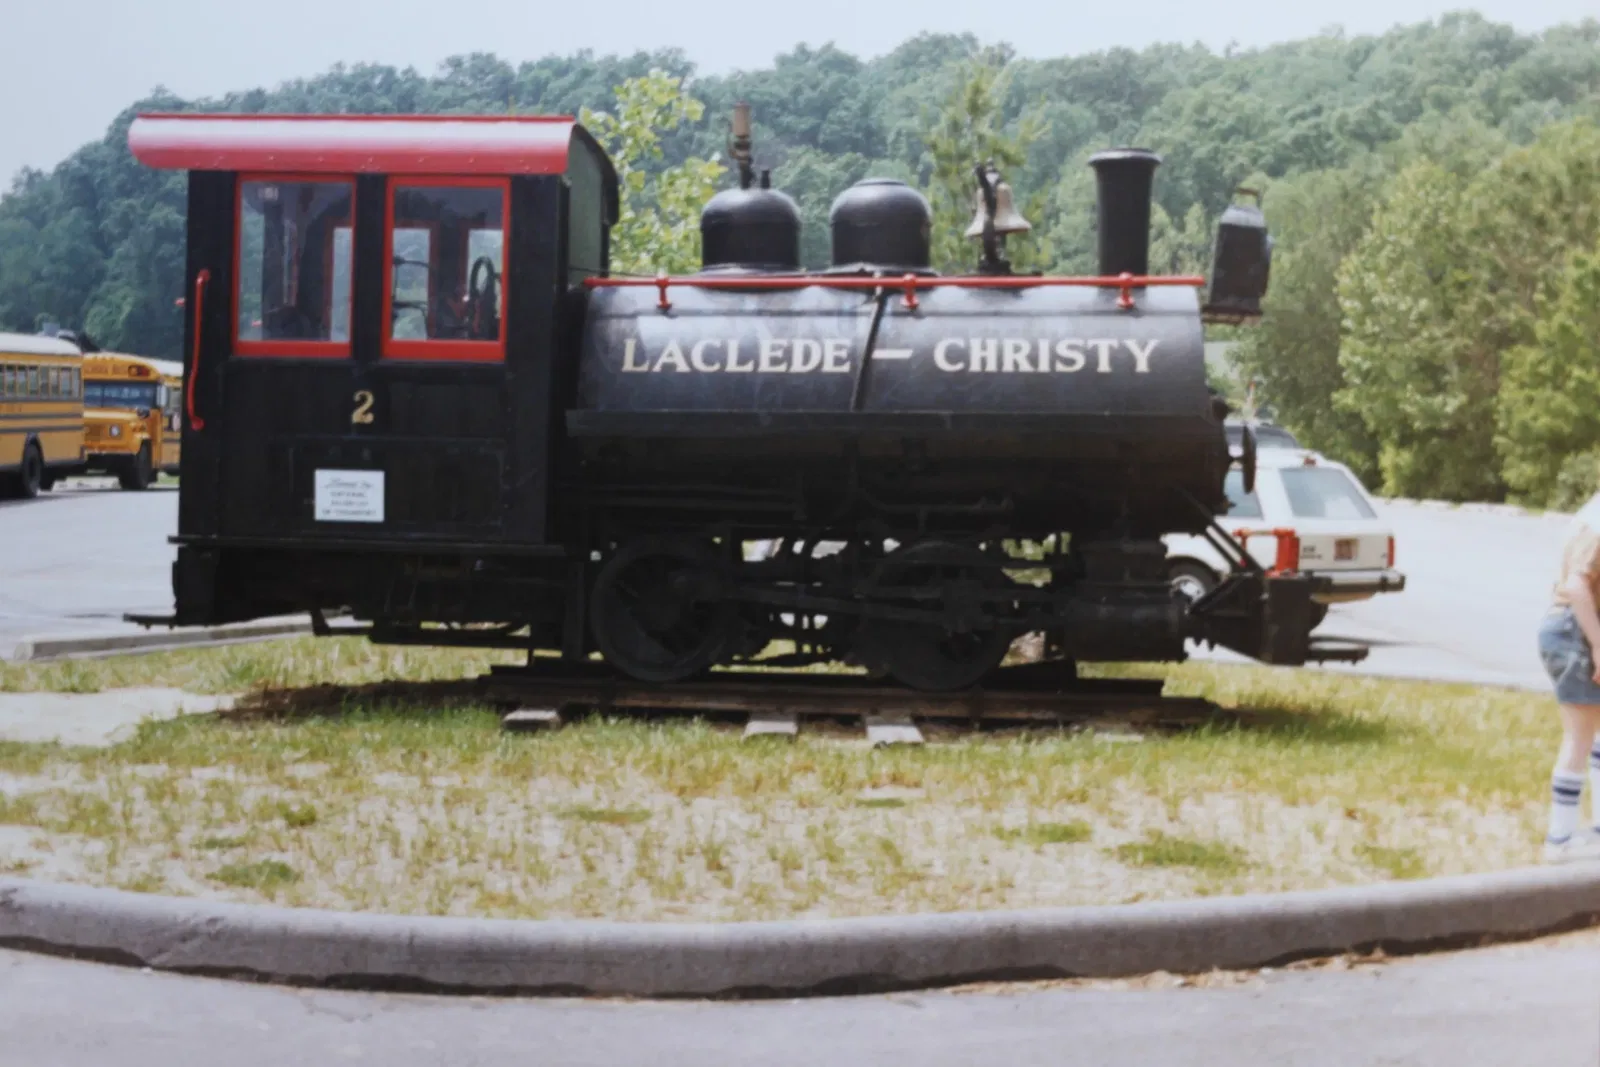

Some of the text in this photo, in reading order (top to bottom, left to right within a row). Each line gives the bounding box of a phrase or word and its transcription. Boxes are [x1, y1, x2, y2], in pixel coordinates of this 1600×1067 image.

[622, 339, 851, 373] LACLEDE
[932, 339, 1159, 373] CHRISTY
[351, 390, 374, 425] 2
